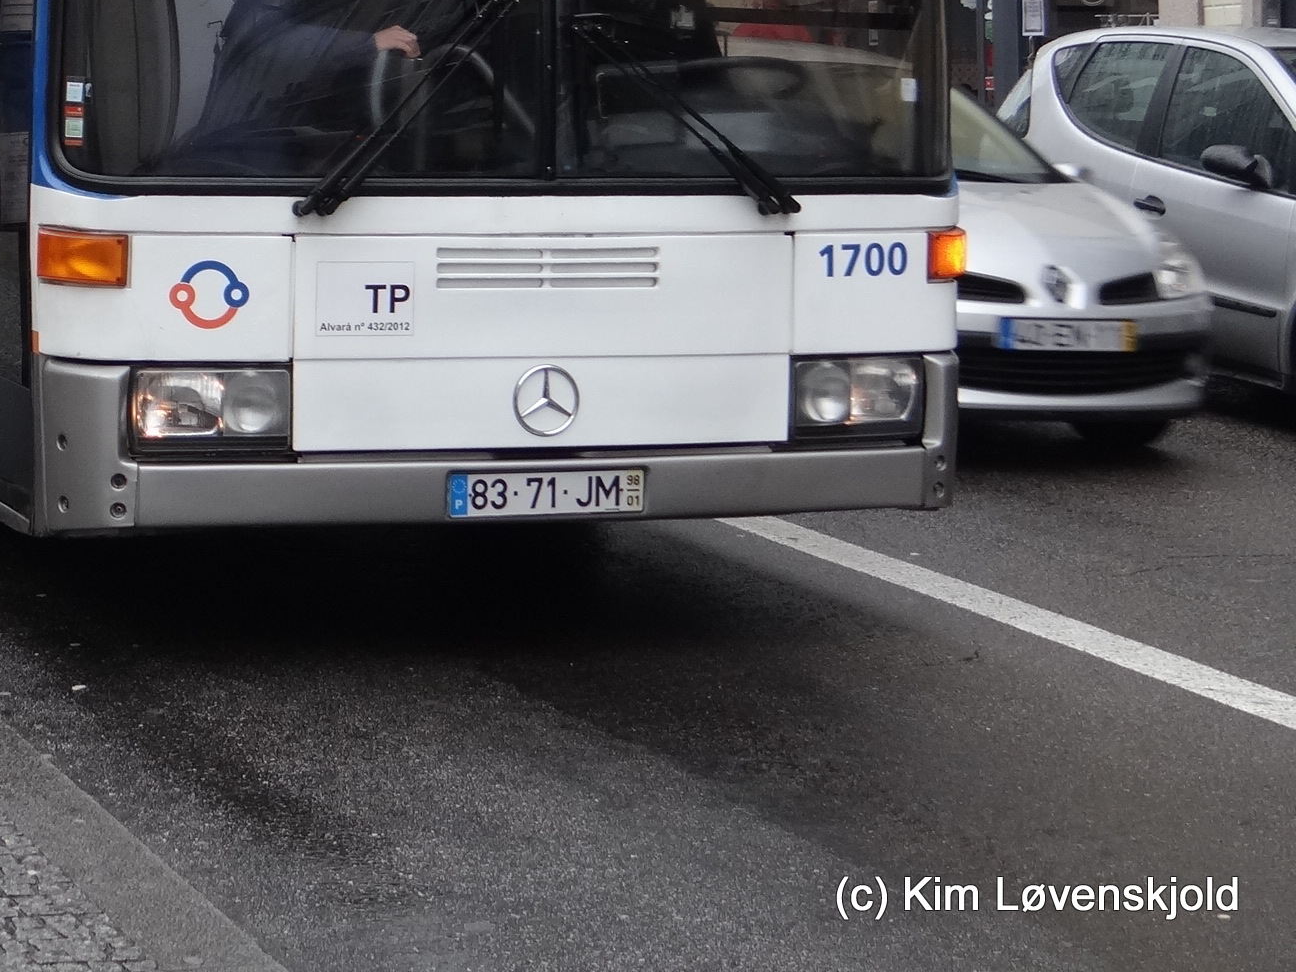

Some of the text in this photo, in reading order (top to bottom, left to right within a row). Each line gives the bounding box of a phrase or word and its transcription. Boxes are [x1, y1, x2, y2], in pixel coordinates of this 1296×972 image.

[819, 241, 908, 278] 1700
[364, 284, 411, 314] TP
[320, 322, 352, 332] Alvará
[367, 321, 411, 331] 432/2012
[626, 475, 641, 486] 98
[455, 499, 464, 510] P
[626, 495, 641, 507] 01
